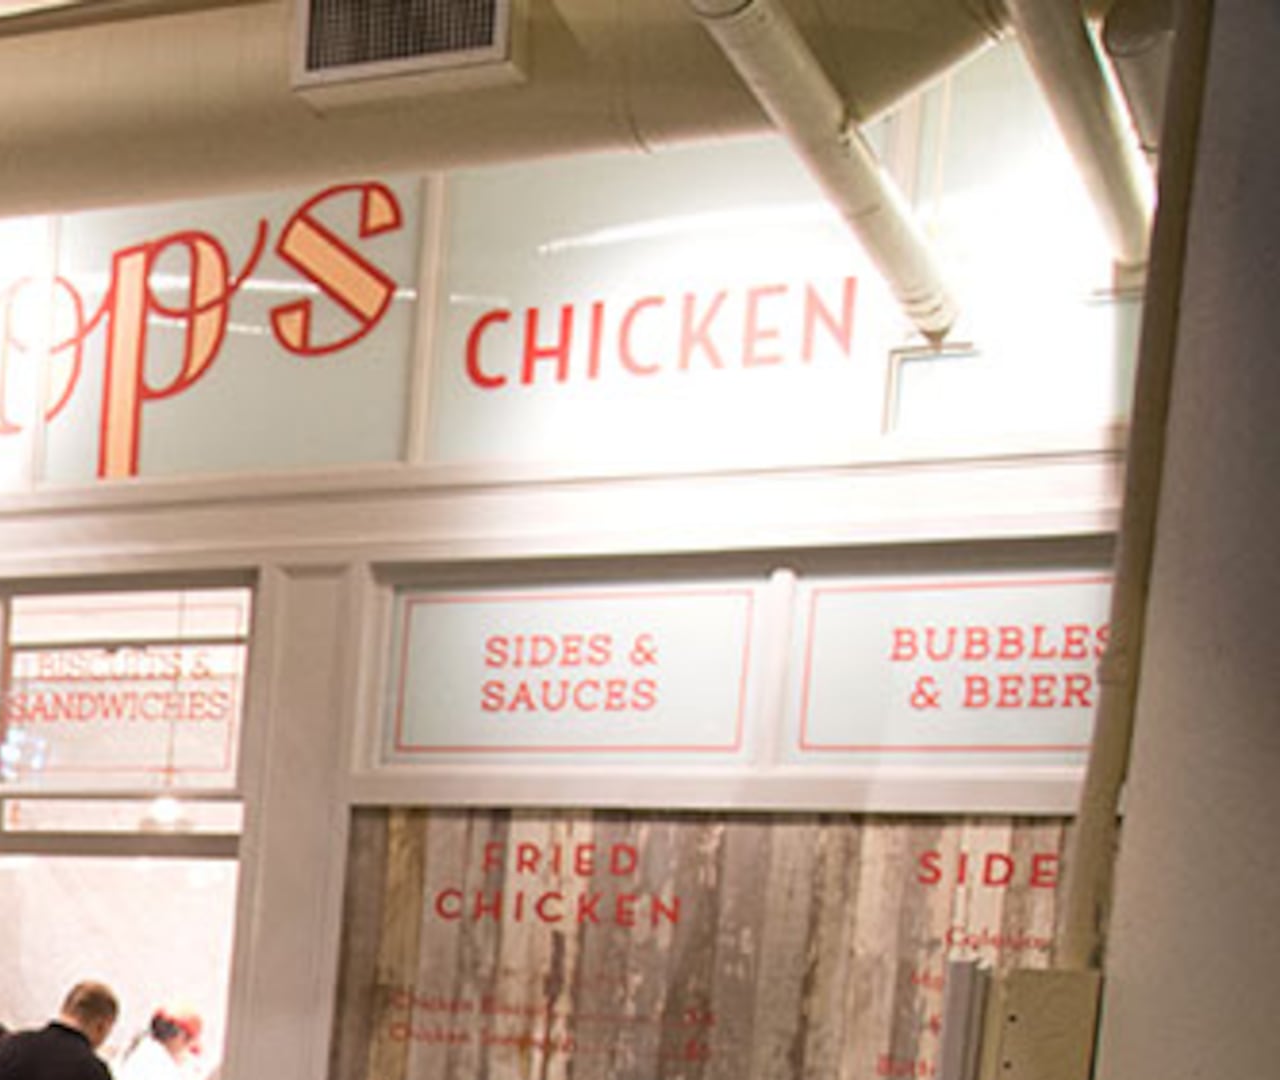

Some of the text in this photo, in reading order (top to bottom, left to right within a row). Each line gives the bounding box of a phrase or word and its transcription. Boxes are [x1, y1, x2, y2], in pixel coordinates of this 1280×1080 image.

[465, 276, 858, 389] CHICKEN
[484, 633, 659, 667] SIDES &
[890, 625, 1111, 663] BUBBLES
[36, 651, 182, 681] BISCUITS
[7, 690, 231, 723] SANDWICHES
[481, 679, 658, 713] SAUCES
[909, 674, 1095, 709] & BEER
[482, 842, 639, 877] FRIED
[917, 850, 1060, 888] SIDE
[434, 888, 682, 927] CHICKEN
